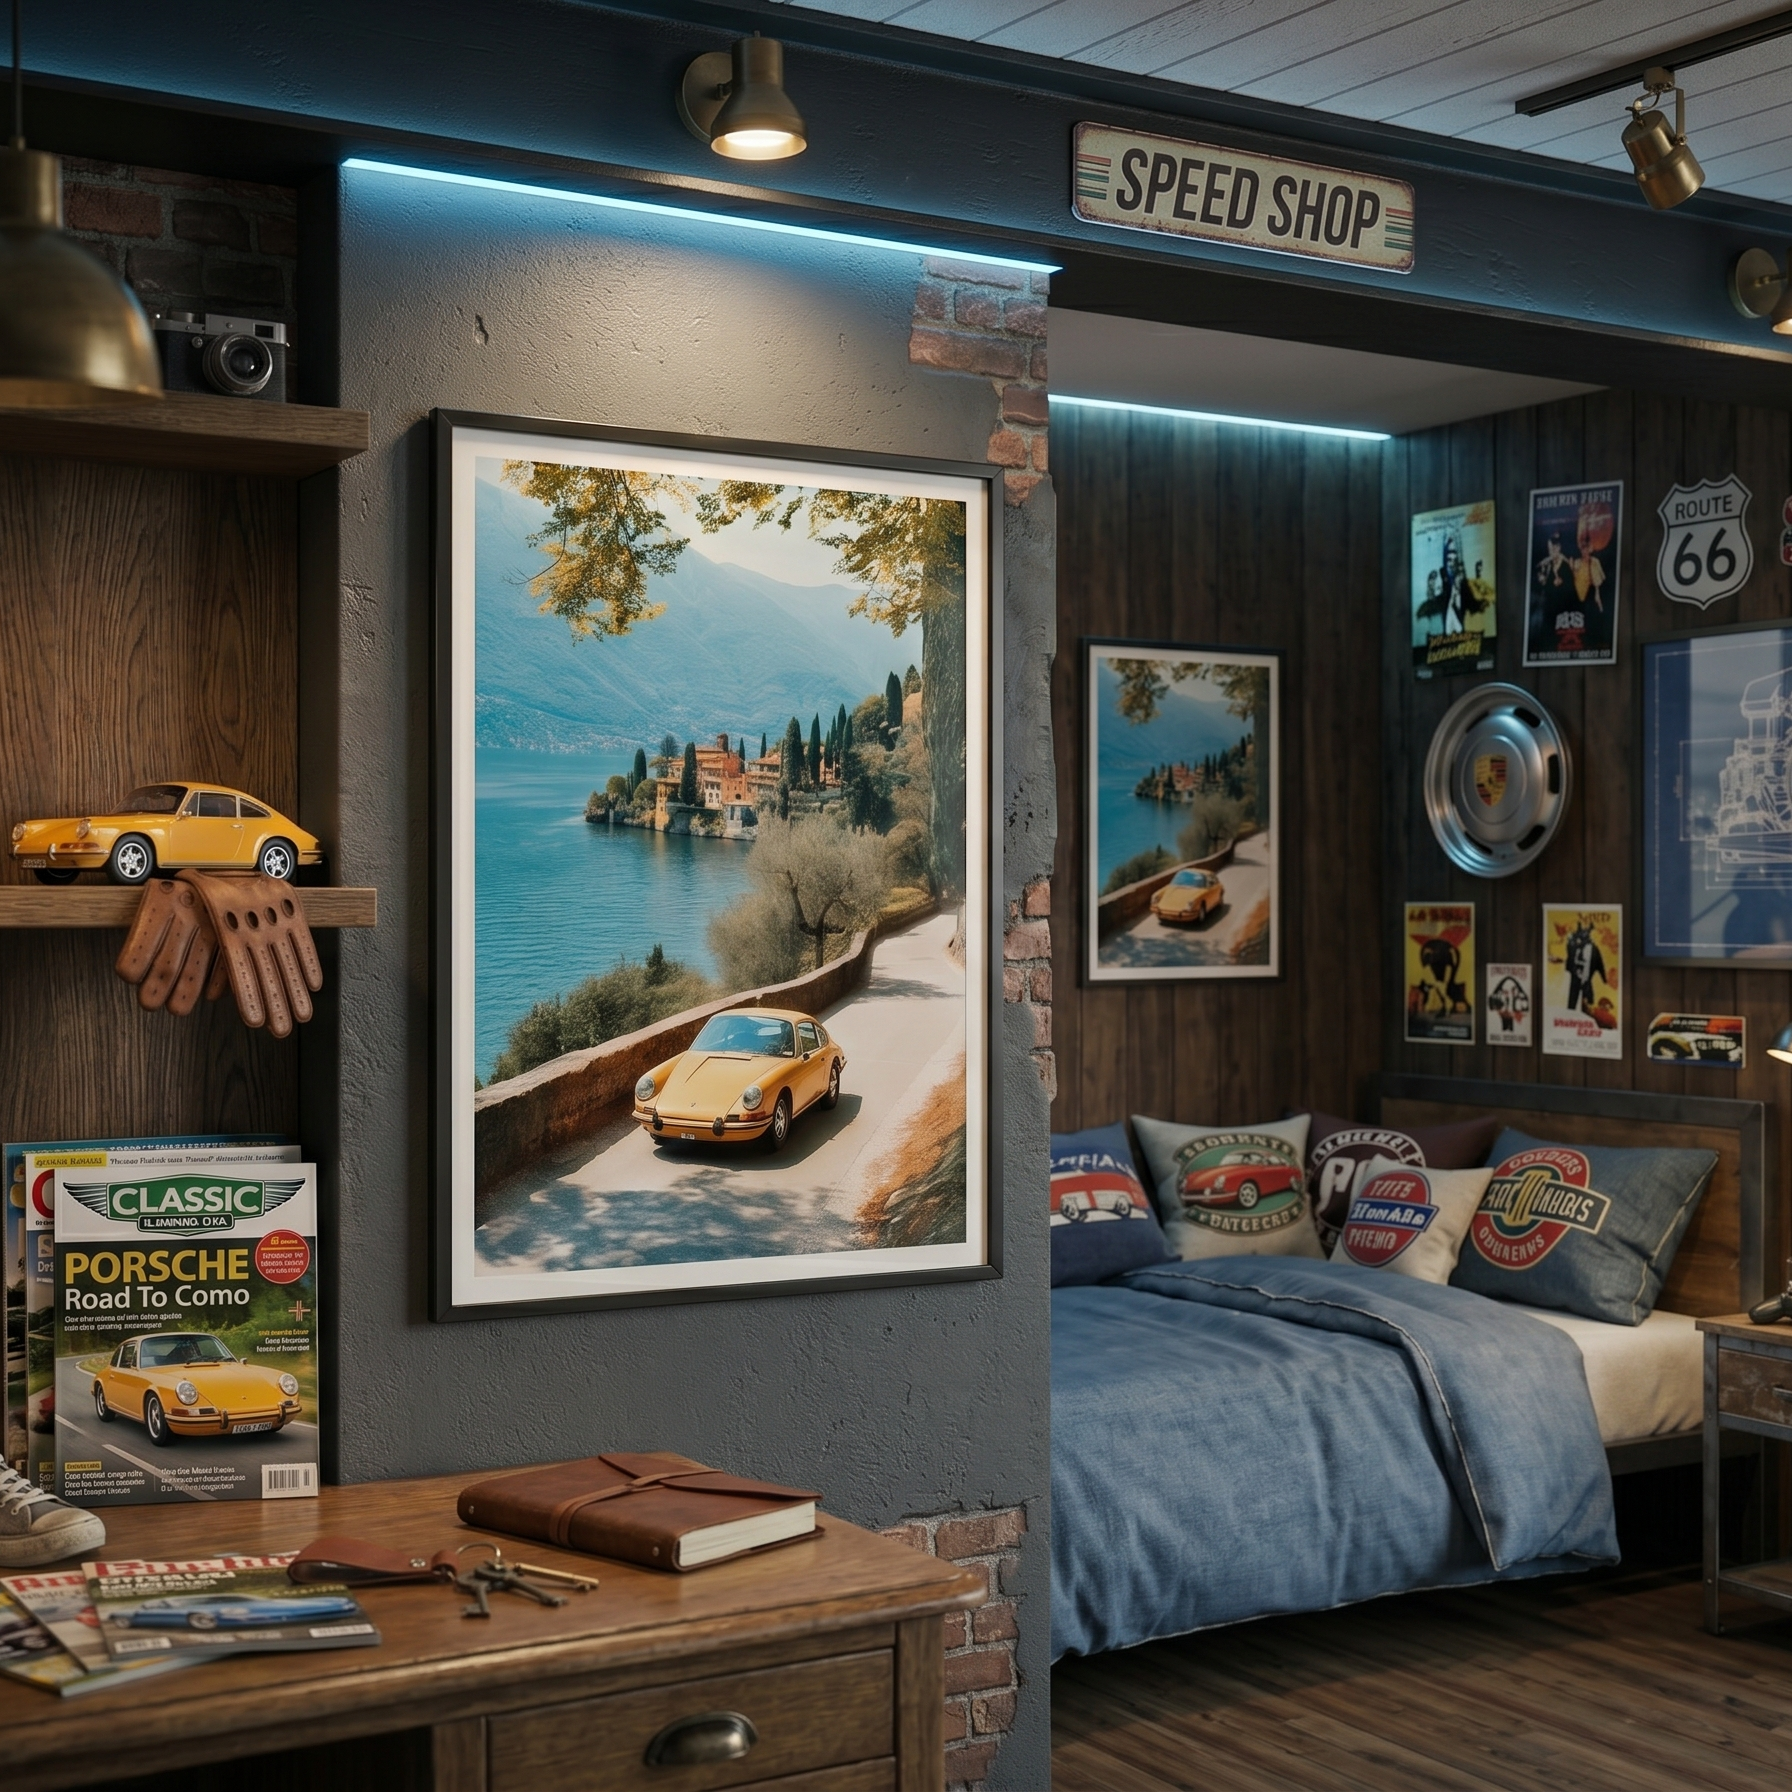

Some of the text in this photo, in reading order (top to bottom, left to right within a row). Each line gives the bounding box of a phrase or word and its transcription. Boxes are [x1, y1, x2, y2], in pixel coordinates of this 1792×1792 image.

[1115, 147, 1381, 250] SPEED SHOP
[1675, 494, 1733, 520] ROUTE
[1673, 527, 1737, 587] 66
[112, 1185, 260, 1216] CLASSIC
[65, 1248, 250, 1284] PORSCHE
[65, 1284, 250, 1311] Road To Como
